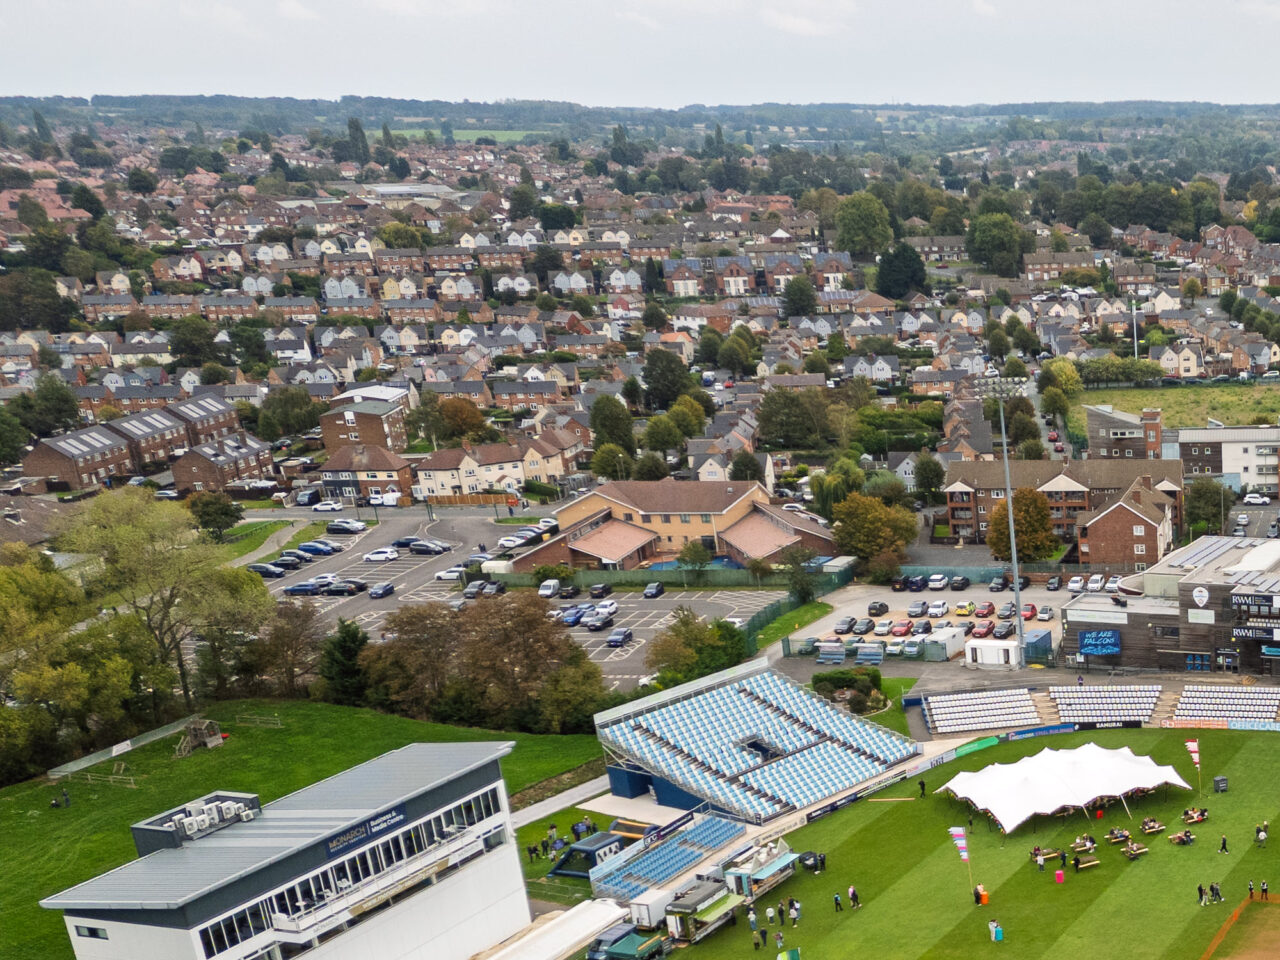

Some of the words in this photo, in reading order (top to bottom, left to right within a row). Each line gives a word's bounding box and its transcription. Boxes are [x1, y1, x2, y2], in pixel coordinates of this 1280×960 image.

[1232, 595, 1252, 604] RWM
[1098, 630, 1113, 638] ARE
[1232, 628, 1253, 637] RWM
[1083, 637, 1115, 645] FALCONS
[328, 826, 366, 848] MONARCH
